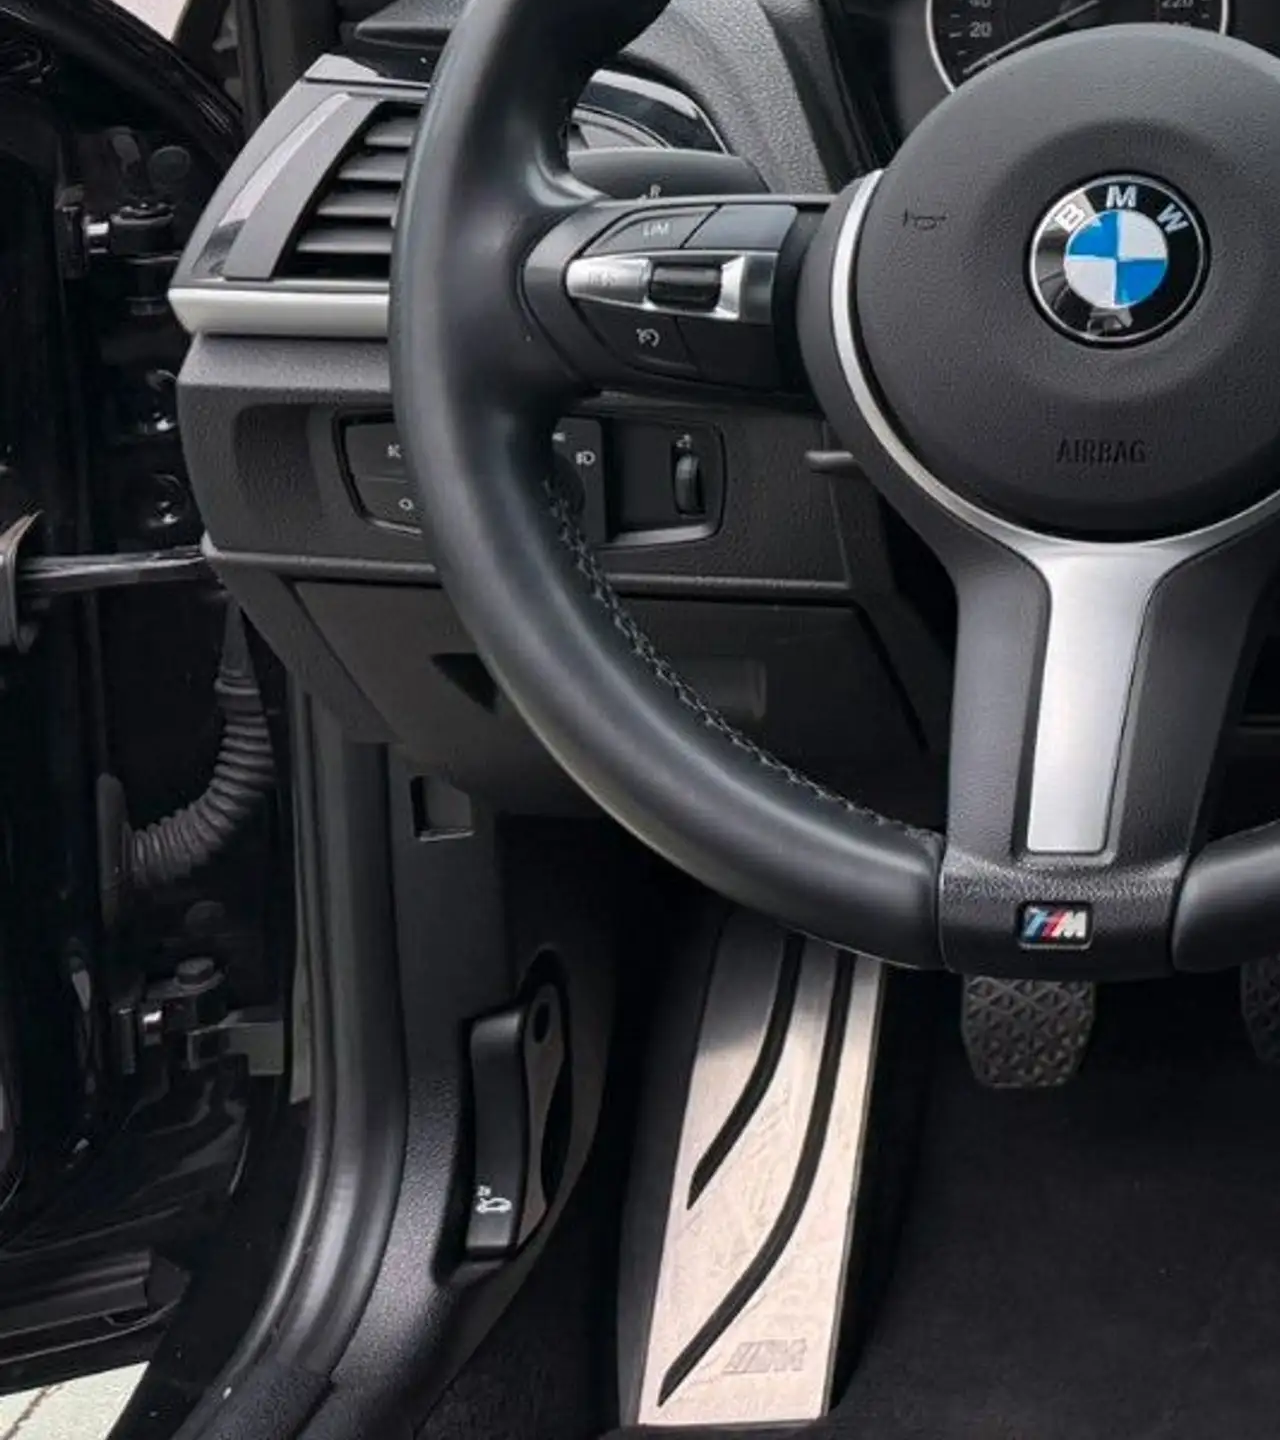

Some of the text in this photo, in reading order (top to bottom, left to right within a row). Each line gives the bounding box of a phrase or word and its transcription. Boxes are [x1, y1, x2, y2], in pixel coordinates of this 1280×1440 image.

[969, 22, 993, 38] 20
[1054, 184, 1190, 235] BMW
[1055, 438, 1146, 464] AIRBAG
